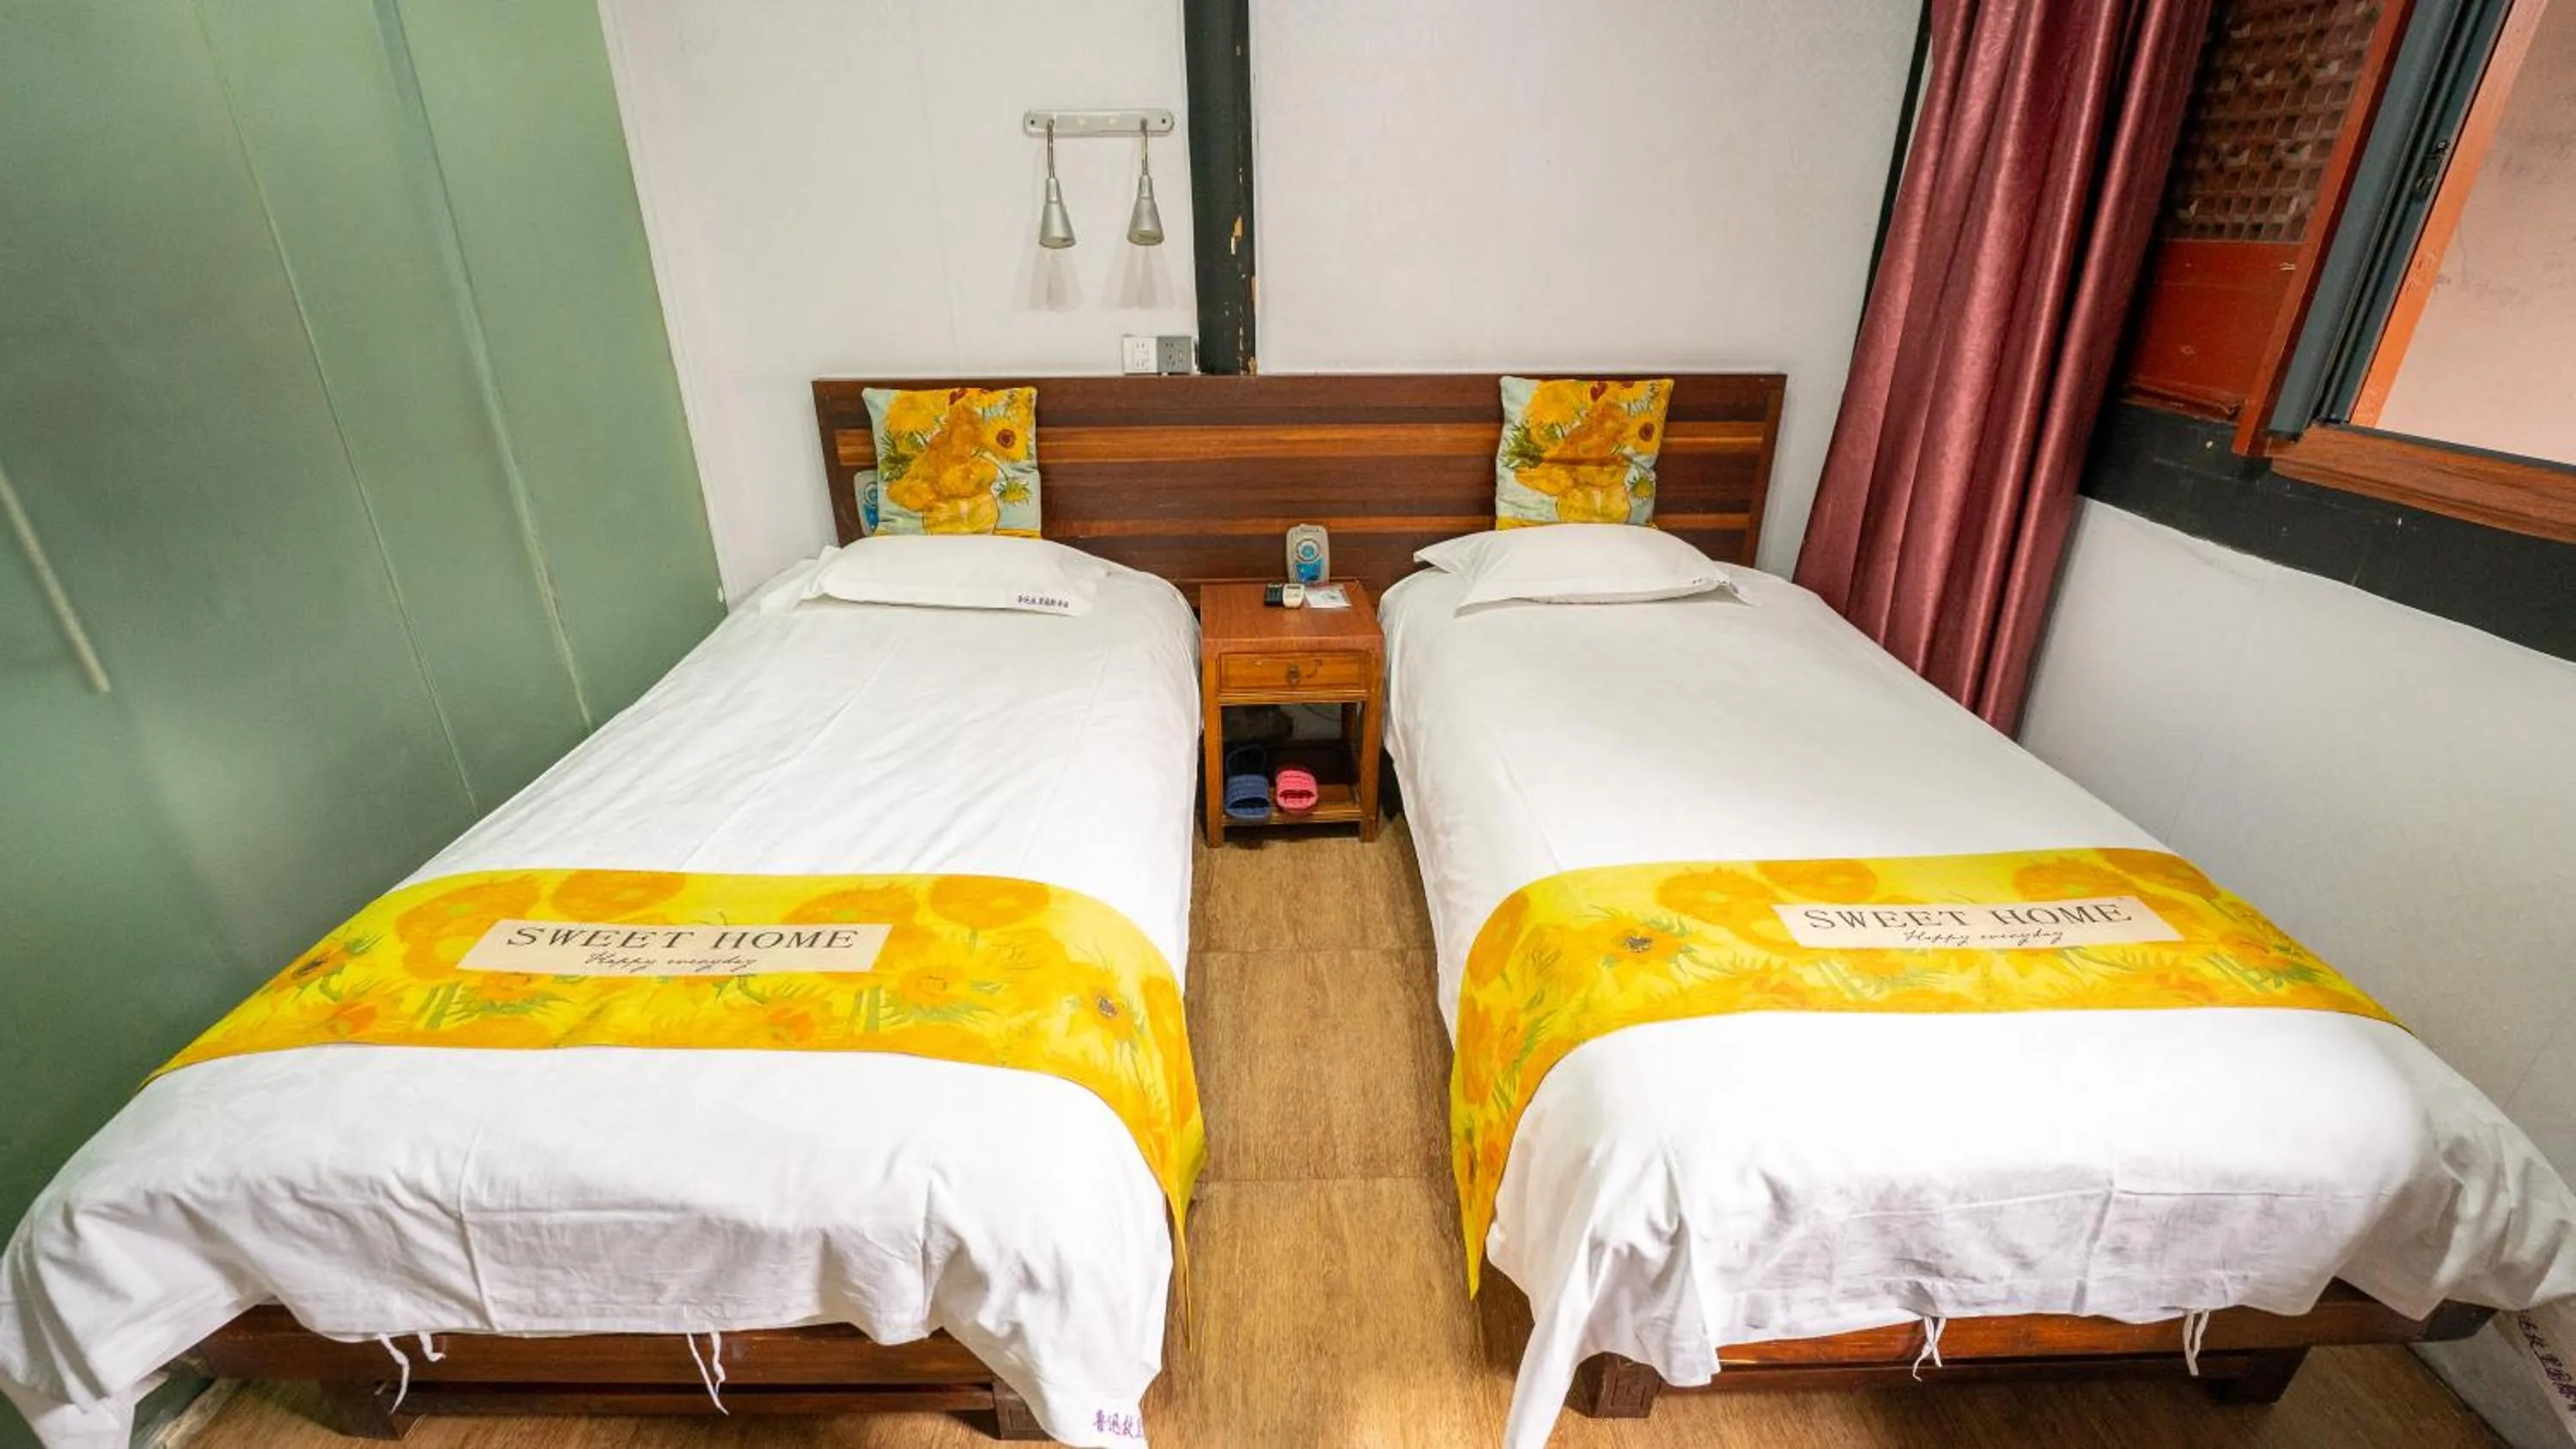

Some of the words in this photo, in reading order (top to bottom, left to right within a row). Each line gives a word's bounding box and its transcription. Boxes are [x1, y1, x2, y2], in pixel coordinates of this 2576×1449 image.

[1804, 909, 1971, 929] SWEET
[1989, 904, 2132, 925] HOME
[507, 927, 694, 949] SWEET
[710, 929, 858, 949] HOME
[1903, 929, 1970, 946] Happy
[585, 949, 658, 973] Happy
